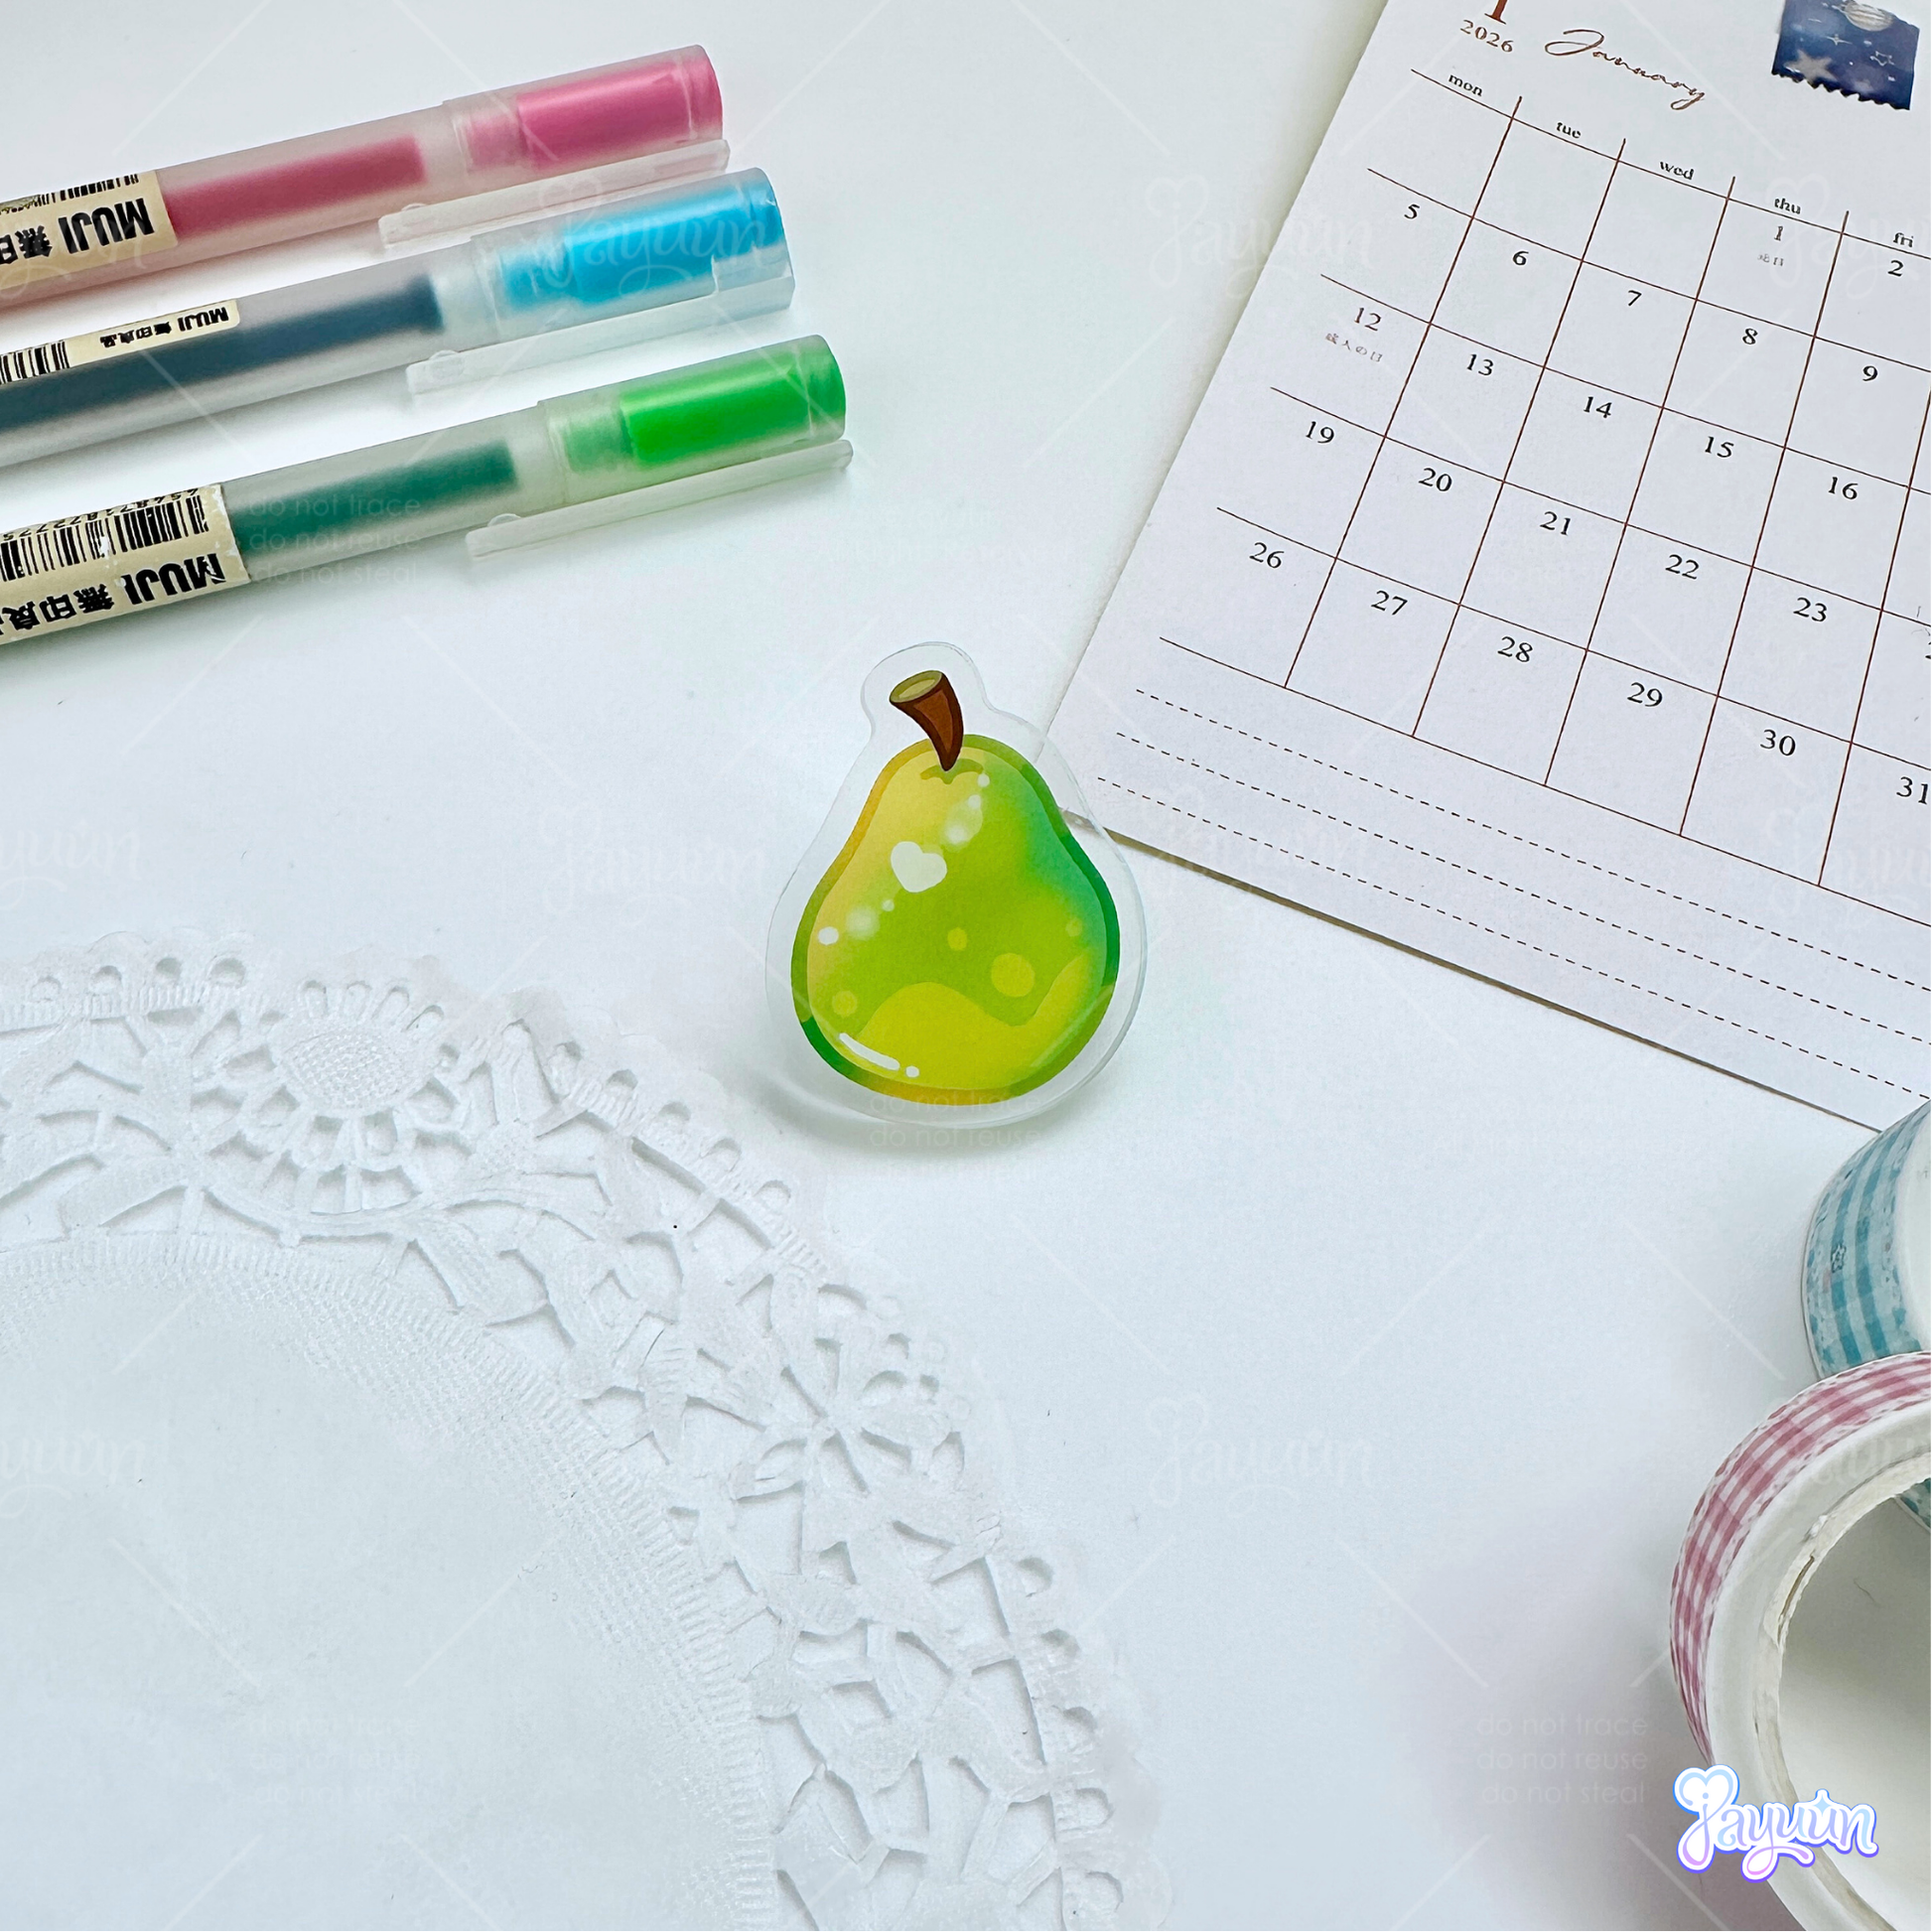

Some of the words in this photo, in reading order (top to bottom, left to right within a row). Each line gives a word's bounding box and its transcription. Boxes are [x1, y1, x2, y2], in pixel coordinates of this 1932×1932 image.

[1459, 19, 1514, 53] 2026
[1544, 29, 1706, 111] January
[1448, 73, 1483, 97] mon
[1555, 120, 1582, 139] tue
[1659, 161, 1695, 180] wed
[1773, 198, 1801, 214] thu
[1892, 232, 1914, 248] fri
[58, 198, 155, 254] MUJI
[1774, 225, 1784, 241] 1
[1887, 259, 1904, 277] 2
[177, 307, 229, 332] MUJI
[1404, 204, 1421, 219] 5
[1512, 250, 1529, 266] 6
[1627, 289, 1642, 307] 7
[1741, 328, 1758, 345] 8
[1863, 365, 1878, 382] 9
[1354, 307, 1382, 332] 12
[1466, 353, 1494, 376] 13
[1583, 396, 1612, 419] 14
[1705, 436, 1734, 459] 15
[1828, 477, 1859, 500] 16
[1306, 421, 1335, 444] 19
[1418, 467, 1452, 492] 20
[1539, 510, 1572, 536] 21
[1665, 554, 1700, 580] 22
[1793, 597, 1828, 622] 23
[0, 584, 115, 636] 無印良
[121, 553, 226, 605] MUJI
[1249, 542, 1285, 569] 26
[1370, 590, 1409, 616] 27
[1497, 635, 1533, 663] 28
[1626, 681, 1663, 708] 29
[1759, 729, 1796, 757] 30
[1895, 776, 1929, 805] 31
